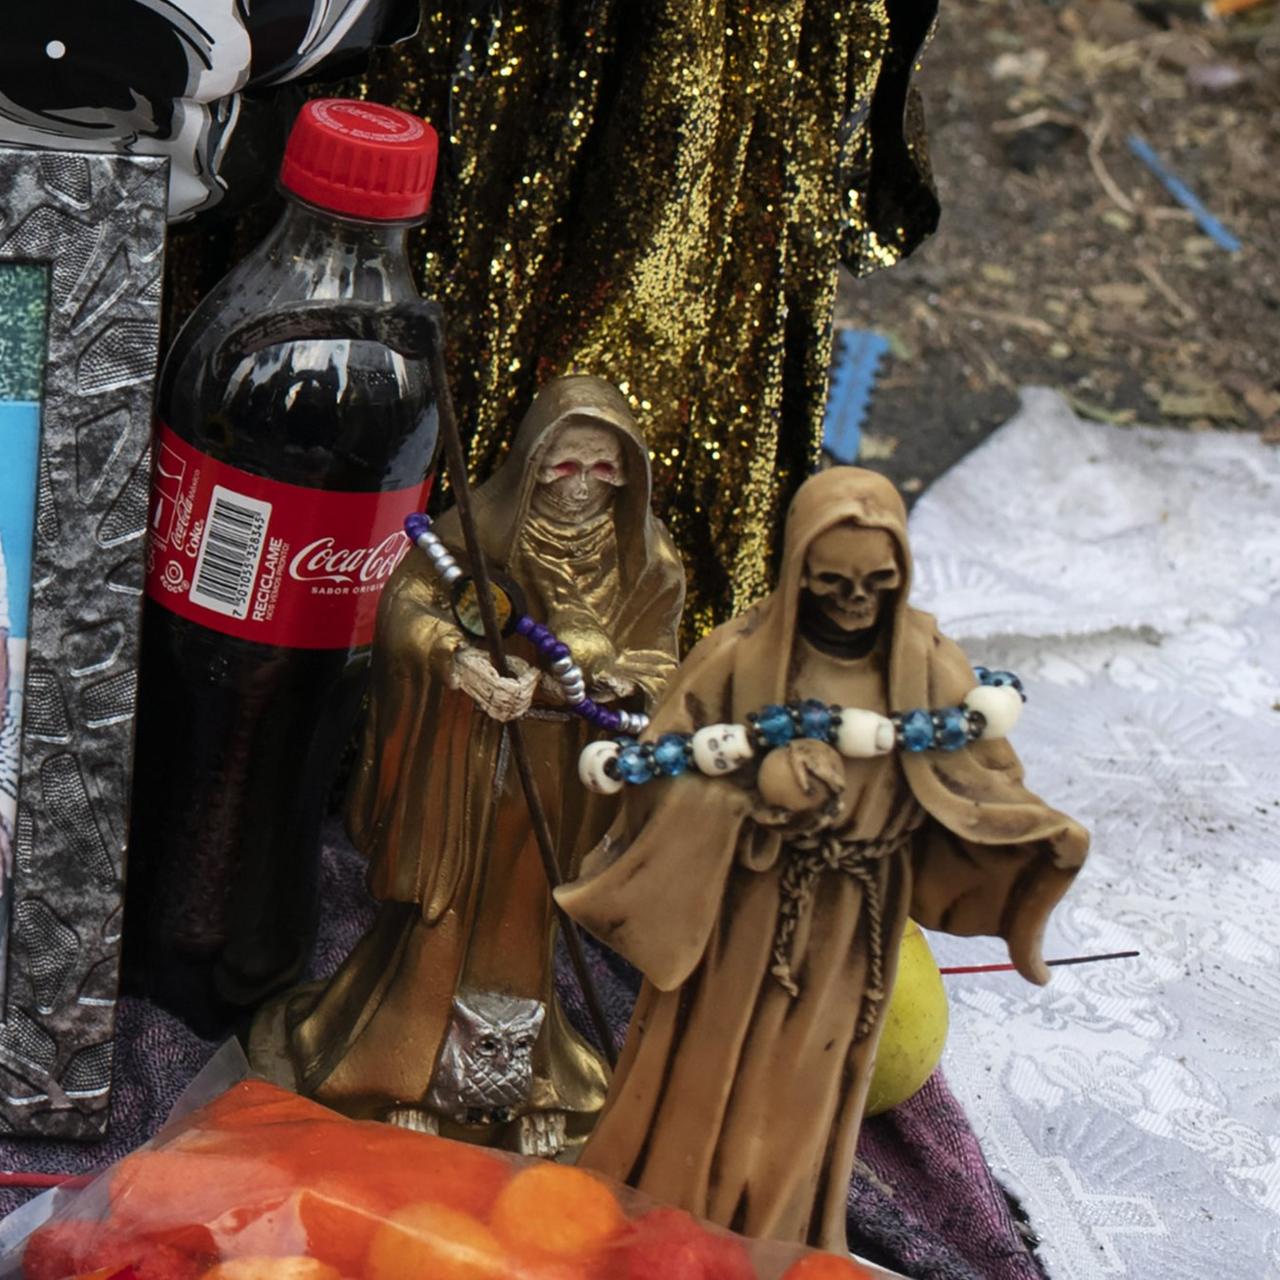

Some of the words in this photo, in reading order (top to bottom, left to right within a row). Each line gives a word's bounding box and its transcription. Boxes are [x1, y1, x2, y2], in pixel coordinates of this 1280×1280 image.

[289, 530, 411, 582] Coca-Col
[252, 537, 283, 621] RECICLAME
[311, 586, 349, 595] SABOR
[232, 608, 243, 617] 7
